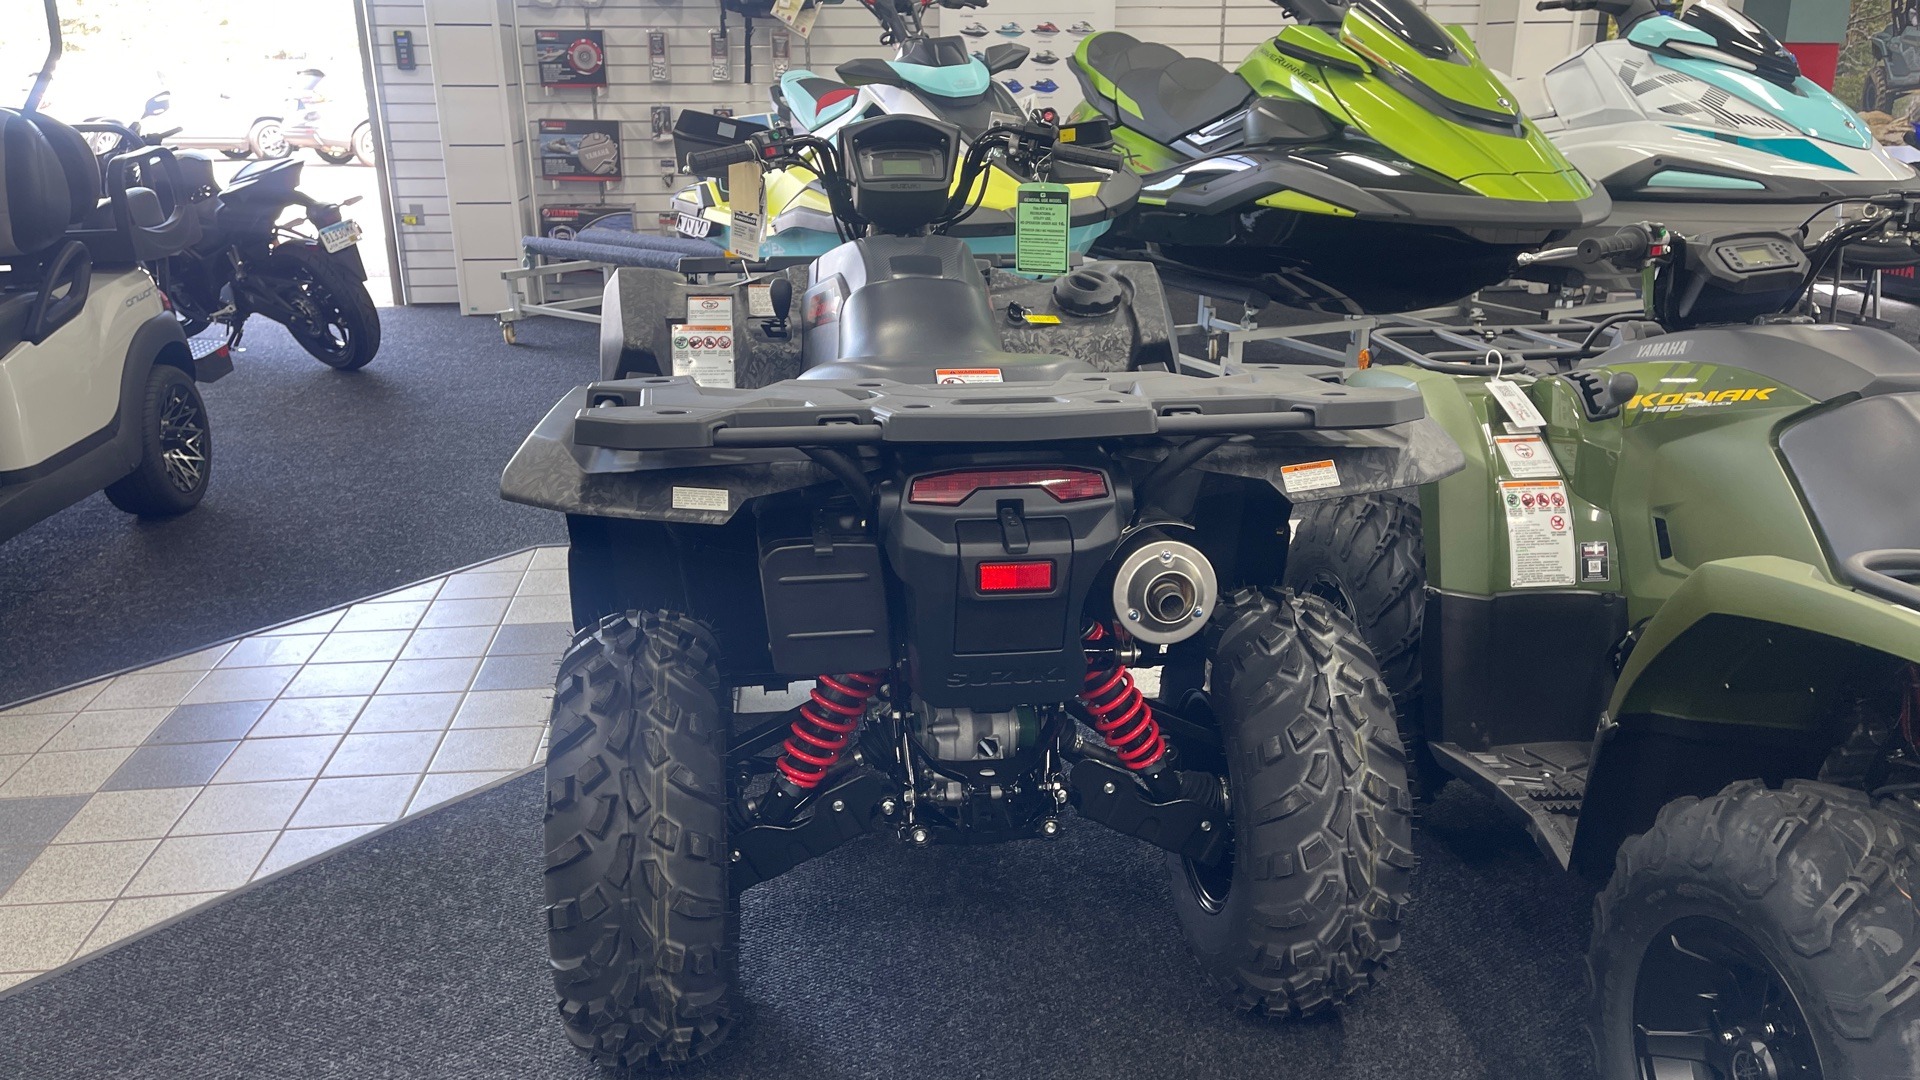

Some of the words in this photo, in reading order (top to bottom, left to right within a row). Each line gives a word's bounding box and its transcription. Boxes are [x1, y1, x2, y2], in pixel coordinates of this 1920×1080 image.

[585, 148, 609, 160] YAMAHA
[550, 209, 578, 217] YAMAHA
[125, 284, 156, 308] onwar
[1636, 340, 1688, 358] YAMAHA
[1626, 388, 1777, 410] KODIAK
[1642, 404, 1686, 413] 450
[946, 667, 1066, 687] SUZUKI
